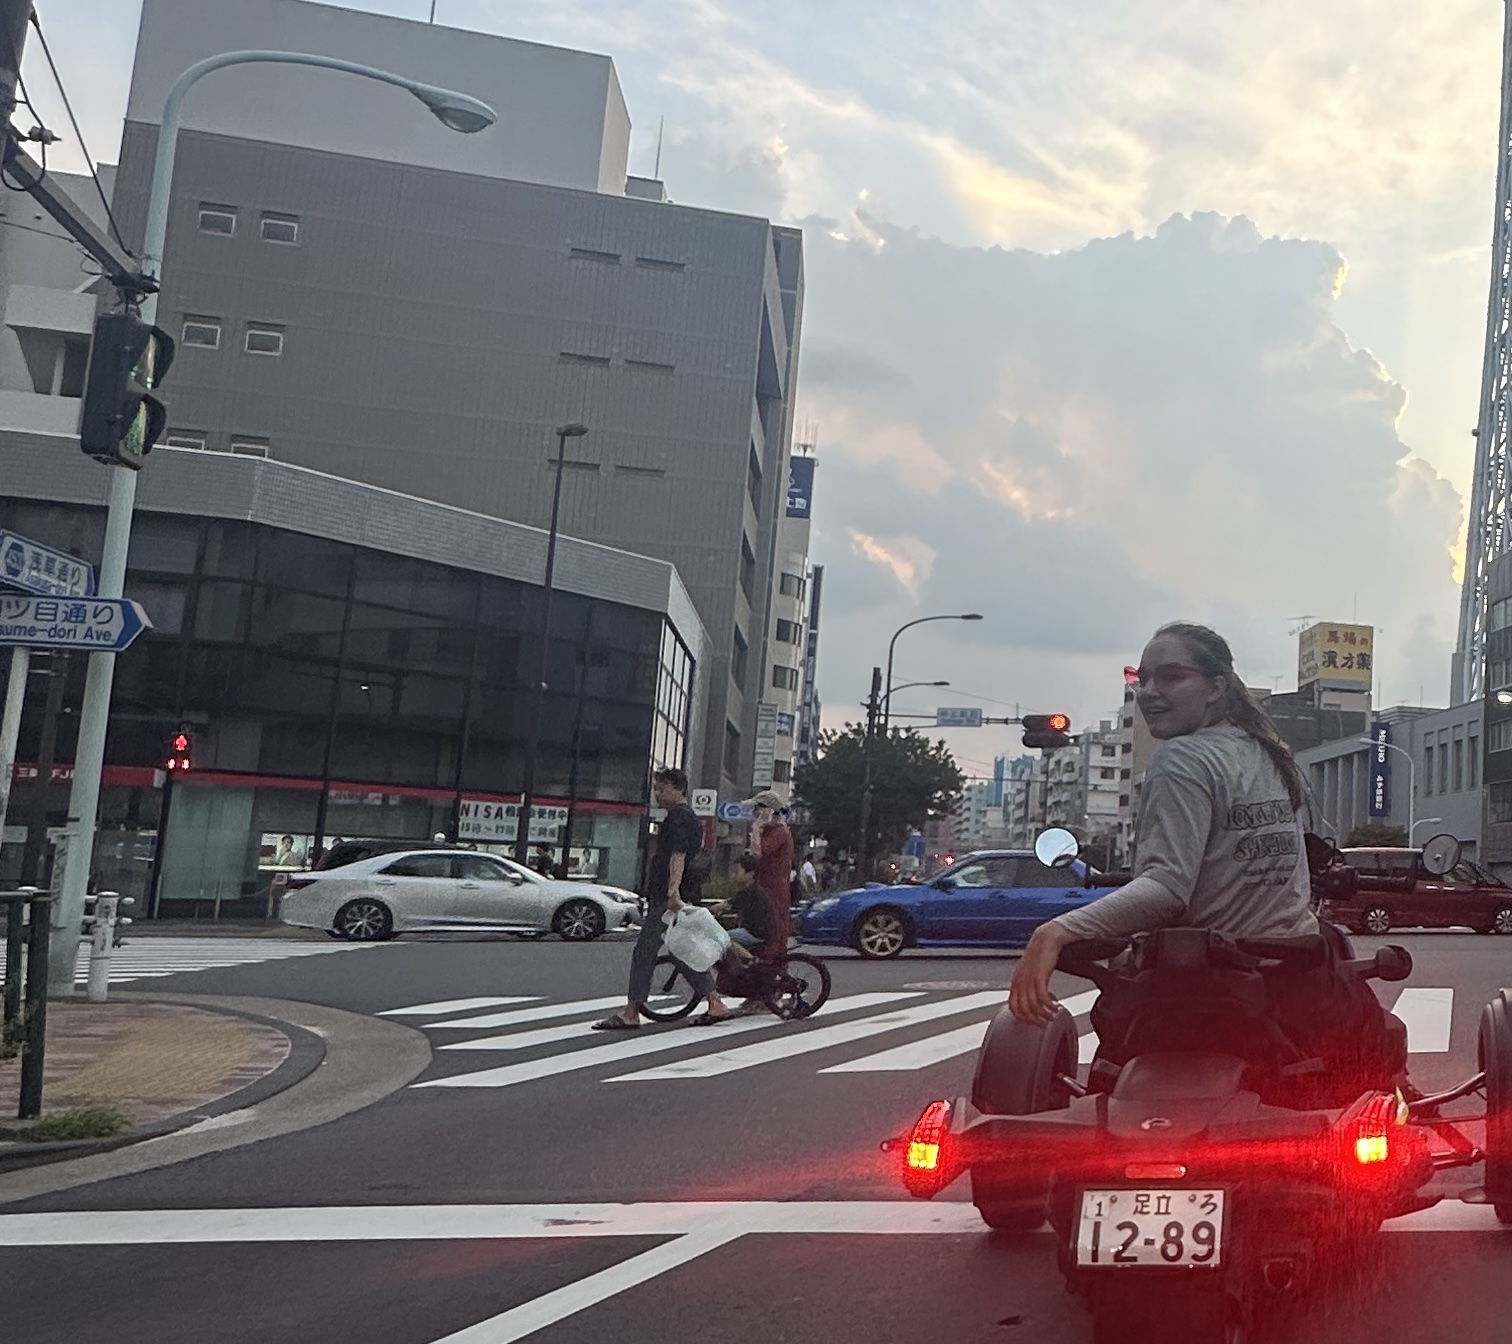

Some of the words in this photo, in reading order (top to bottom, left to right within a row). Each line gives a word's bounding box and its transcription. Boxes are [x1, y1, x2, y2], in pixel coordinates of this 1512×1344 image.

[0, 599, 114, 624] ツ目通り
[83, 626, 115, 642] Ave.
[1321, 650, 1371, 670] 漢方薬
[1133, 1193, 1172, 1215] 足立
[1200, 1193, 1218, 1215] ろ
[1090, 1220, 1216, 1263] 12-89
